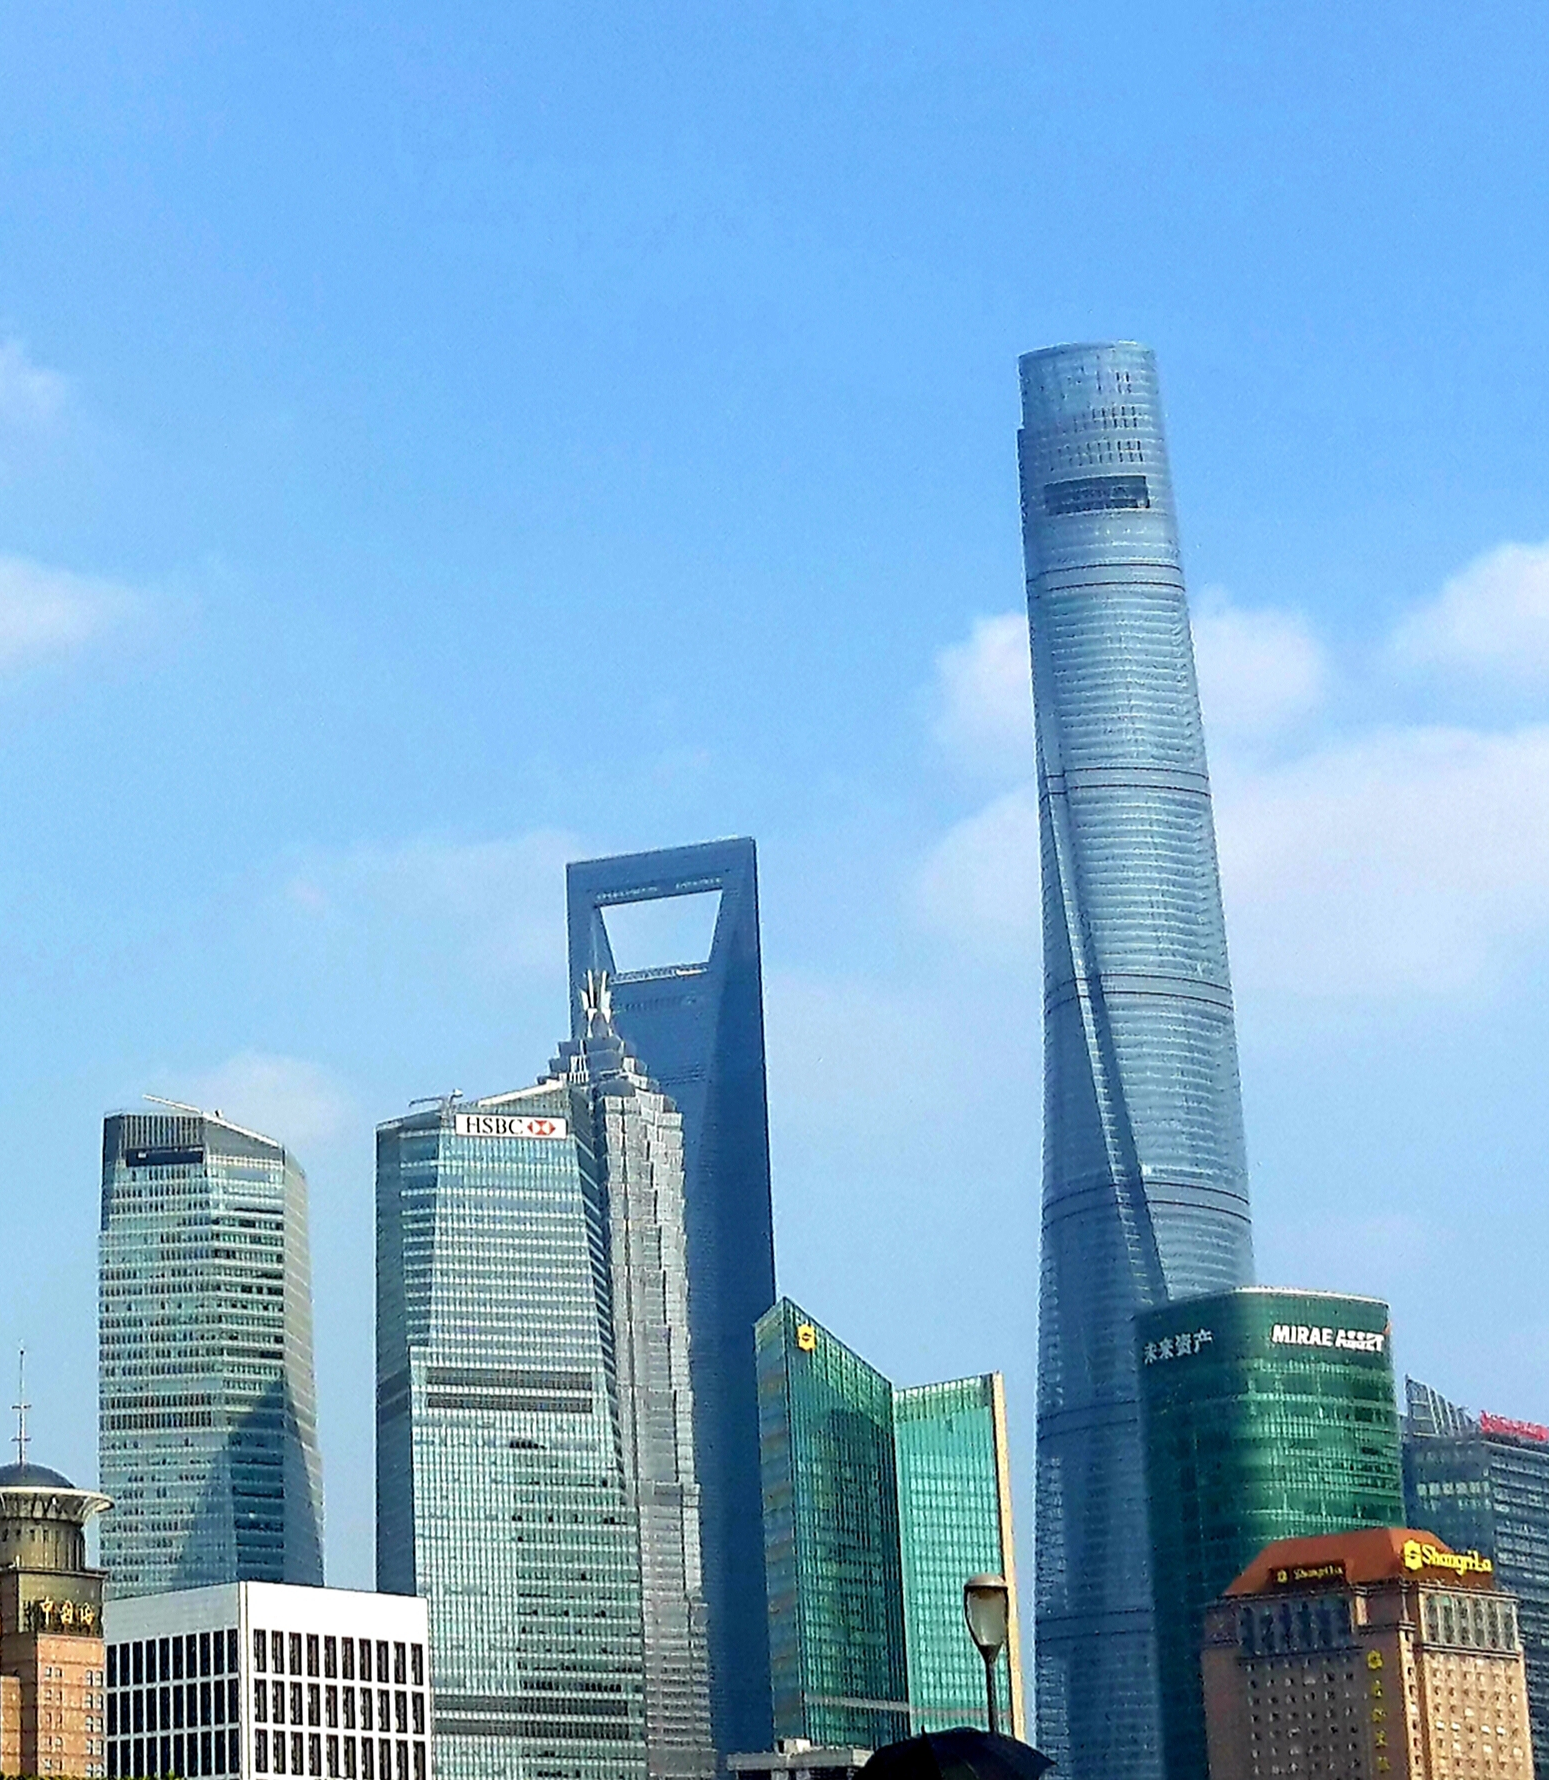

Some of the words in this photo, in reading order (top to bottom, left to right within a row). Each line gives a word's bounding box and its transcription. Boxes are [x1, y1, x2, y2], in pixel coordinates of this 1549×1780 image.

[466, 1116, 524, 1135] HSBC
[1143, 1328, 1214, 1365] 未来资产
[1271, 1323, 1333, 1347] MIRAE
[1334, 1329, 1386, 1352] ASSET
